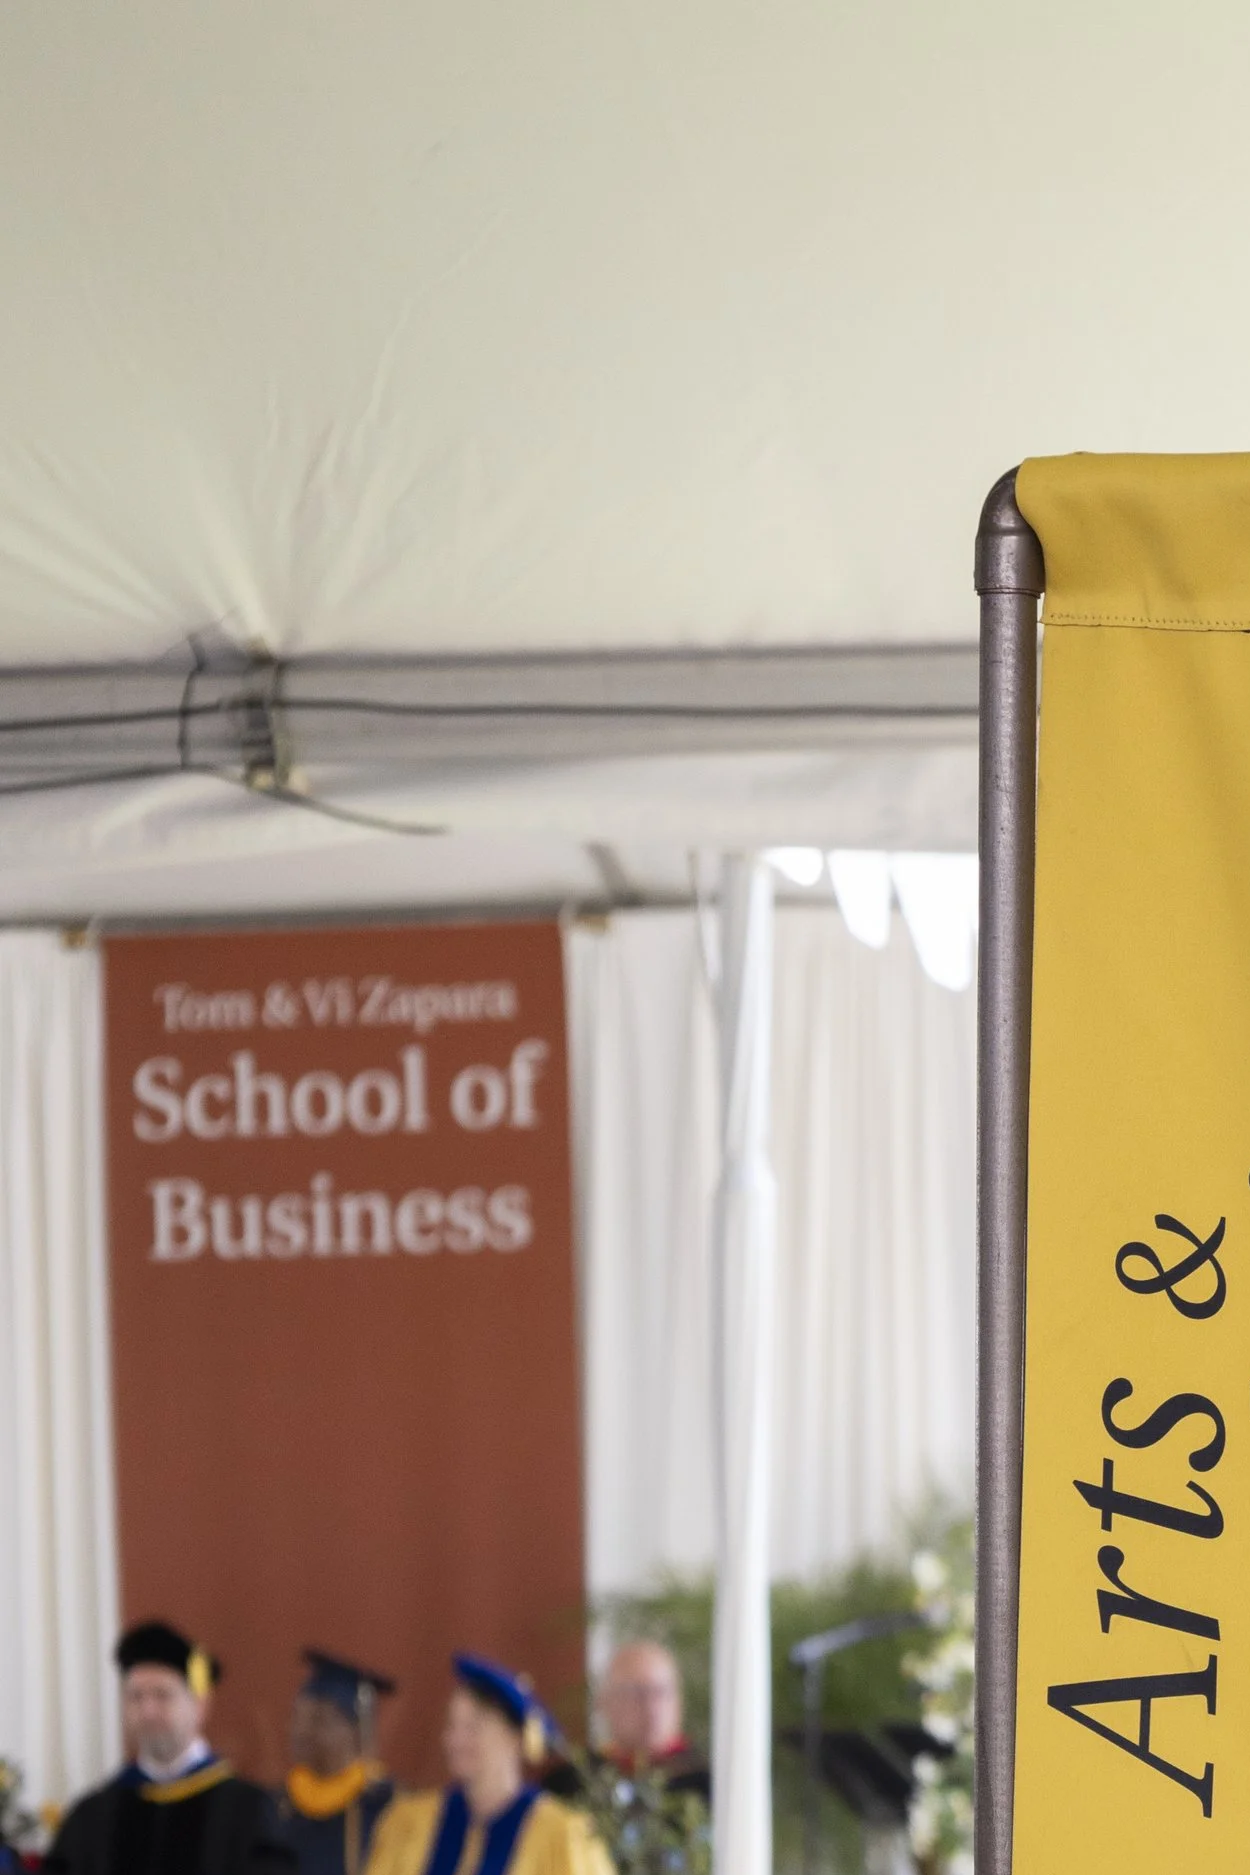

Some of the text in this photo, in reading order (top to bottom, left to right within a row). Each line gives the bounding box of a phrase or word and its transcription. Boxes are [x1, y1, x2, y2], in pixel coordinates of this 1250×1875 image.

[262, 979, 297, 1030] &
[132, 1038, 549, 1141] School of
[149, 1171, 534, 1261] Business
[1046, 1213, 1227, 1819] Arts &
